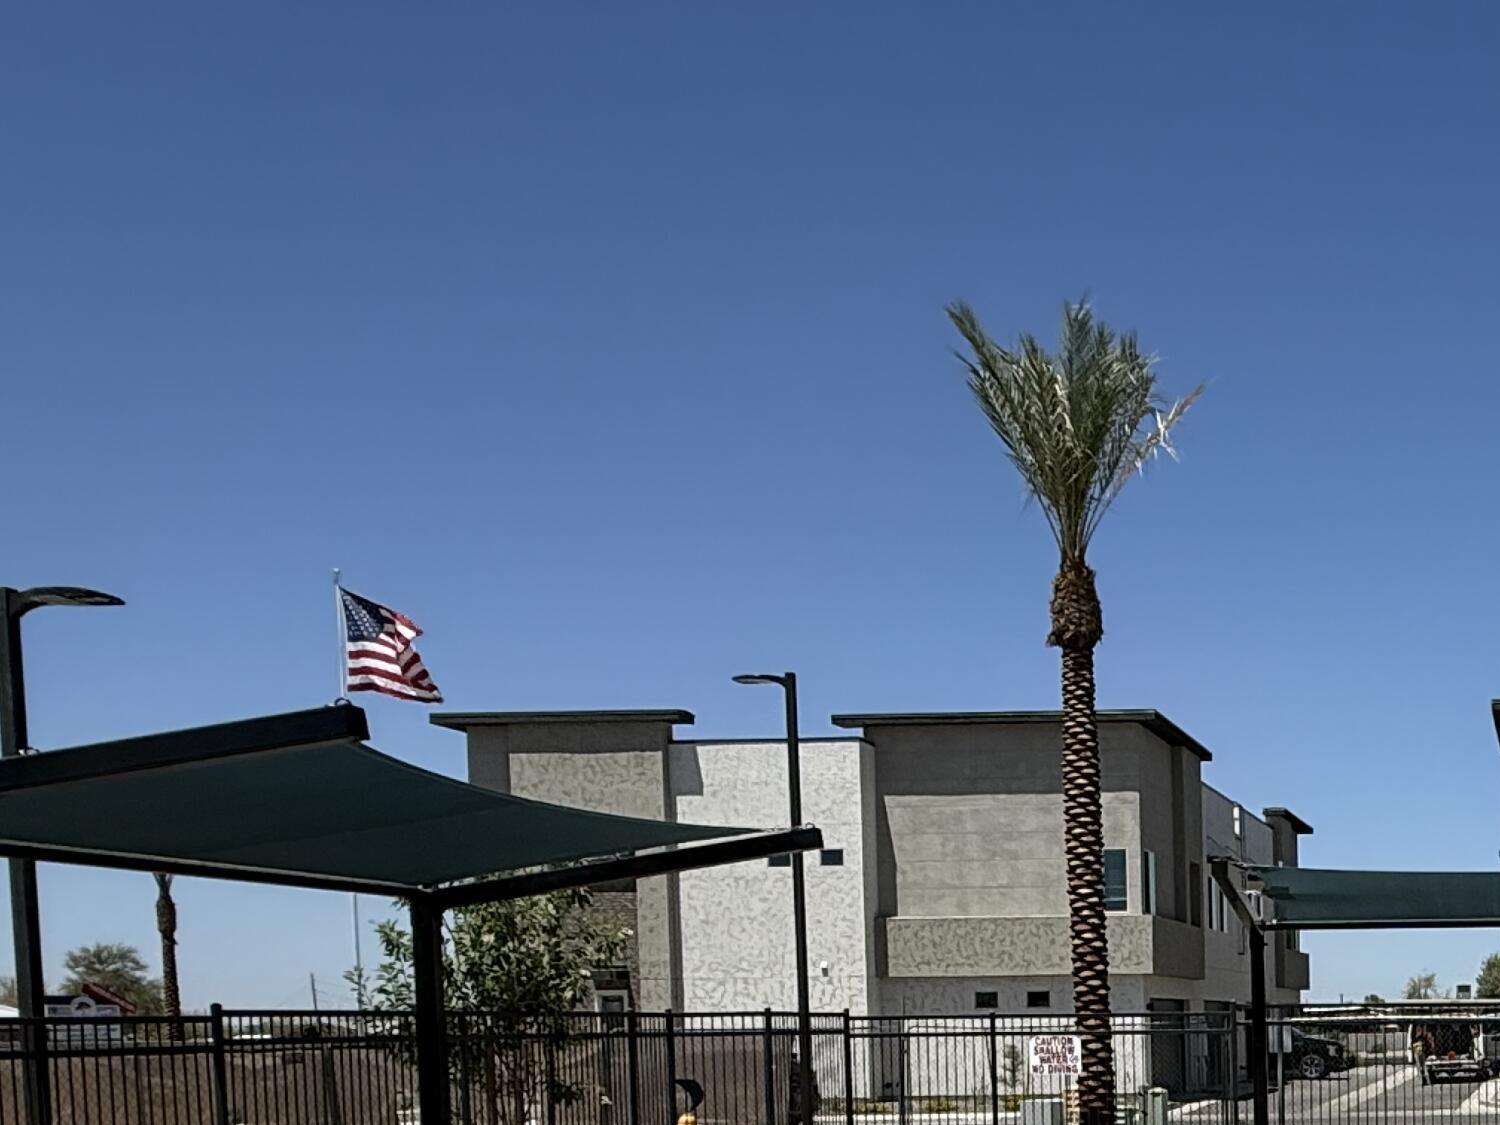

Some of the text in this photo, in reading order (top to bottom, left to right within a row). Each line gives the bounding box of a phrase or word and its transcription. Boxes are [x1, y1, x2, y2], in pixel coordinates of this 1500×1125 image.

[1034, 1036, 1073, 1046] CAUTION
[1034, 1046, 1075, 1055] SHALLOW
[1040, 1055, 1068, 1064] WATER
[1032, 1064, 1078, 1073] NO DIVING
